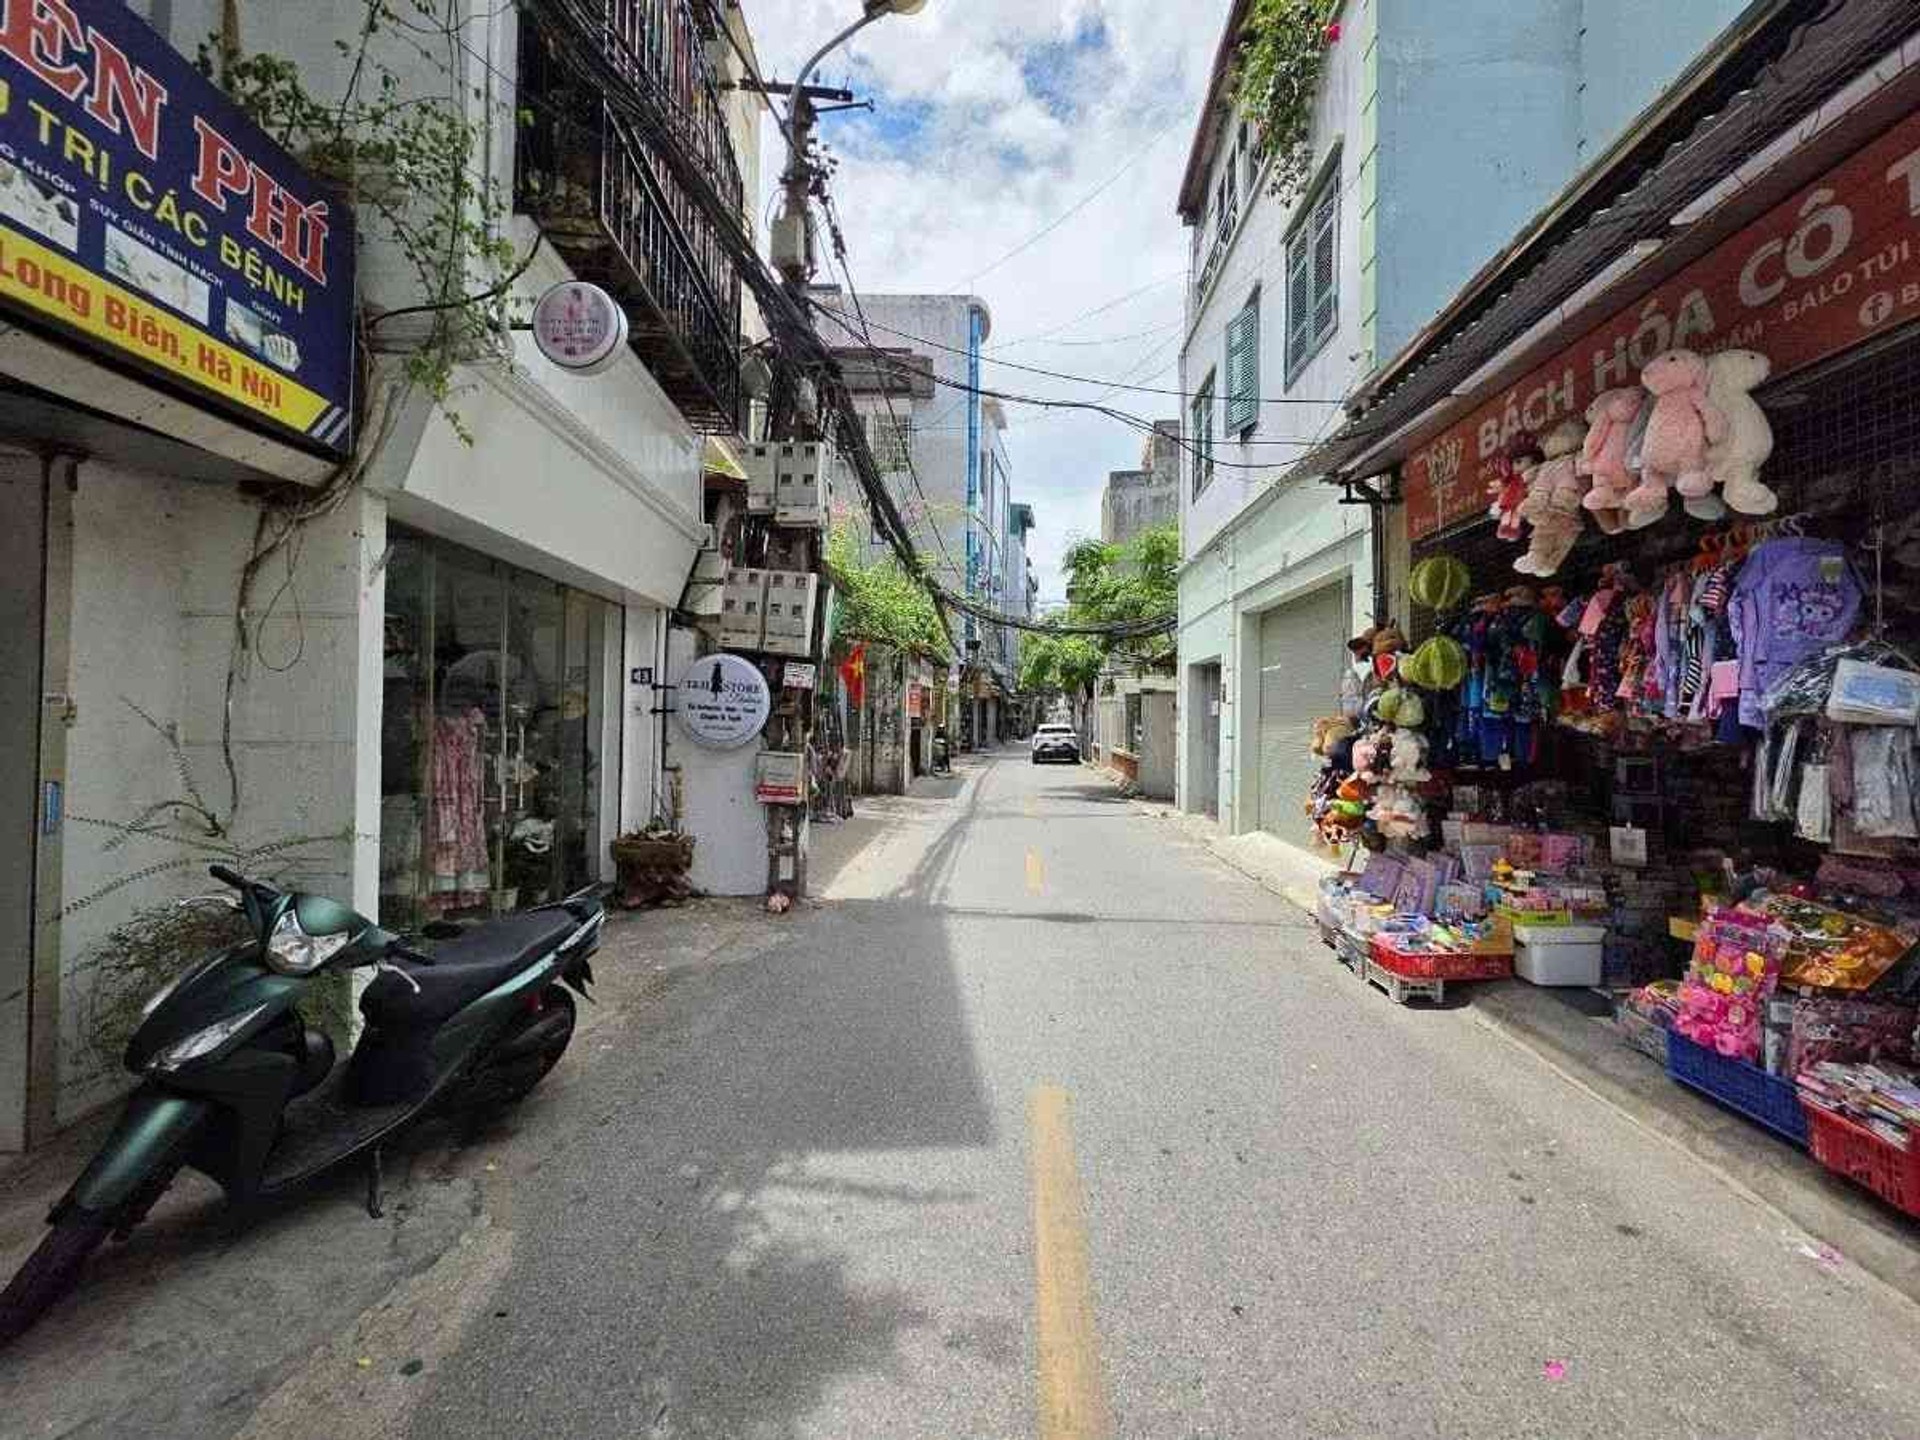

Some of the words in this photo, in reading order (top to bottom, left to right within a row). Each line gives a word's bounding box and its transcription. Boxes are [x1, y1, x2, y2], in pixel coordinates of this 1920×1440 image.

[28, 100, 110, 193] TRỊ
[125, 171, 208, 247] CÁC
[219, 232, 305, 314] BỆNH
[192, 115, 331, 287] PHÍ
[1782, 272, 1854, 322] BALO
[1858, 239, 1910, 281] TÚI
[0, 239, 92, 319] Long
[103, 293, 188, 367] Biên,
[198, 342, 233, 387] Hà
[241, 363, 282, 410] Nội
[1478, 367, 1575, 459] BÁCH
[1593, 288, 1716, 393] HÓA
